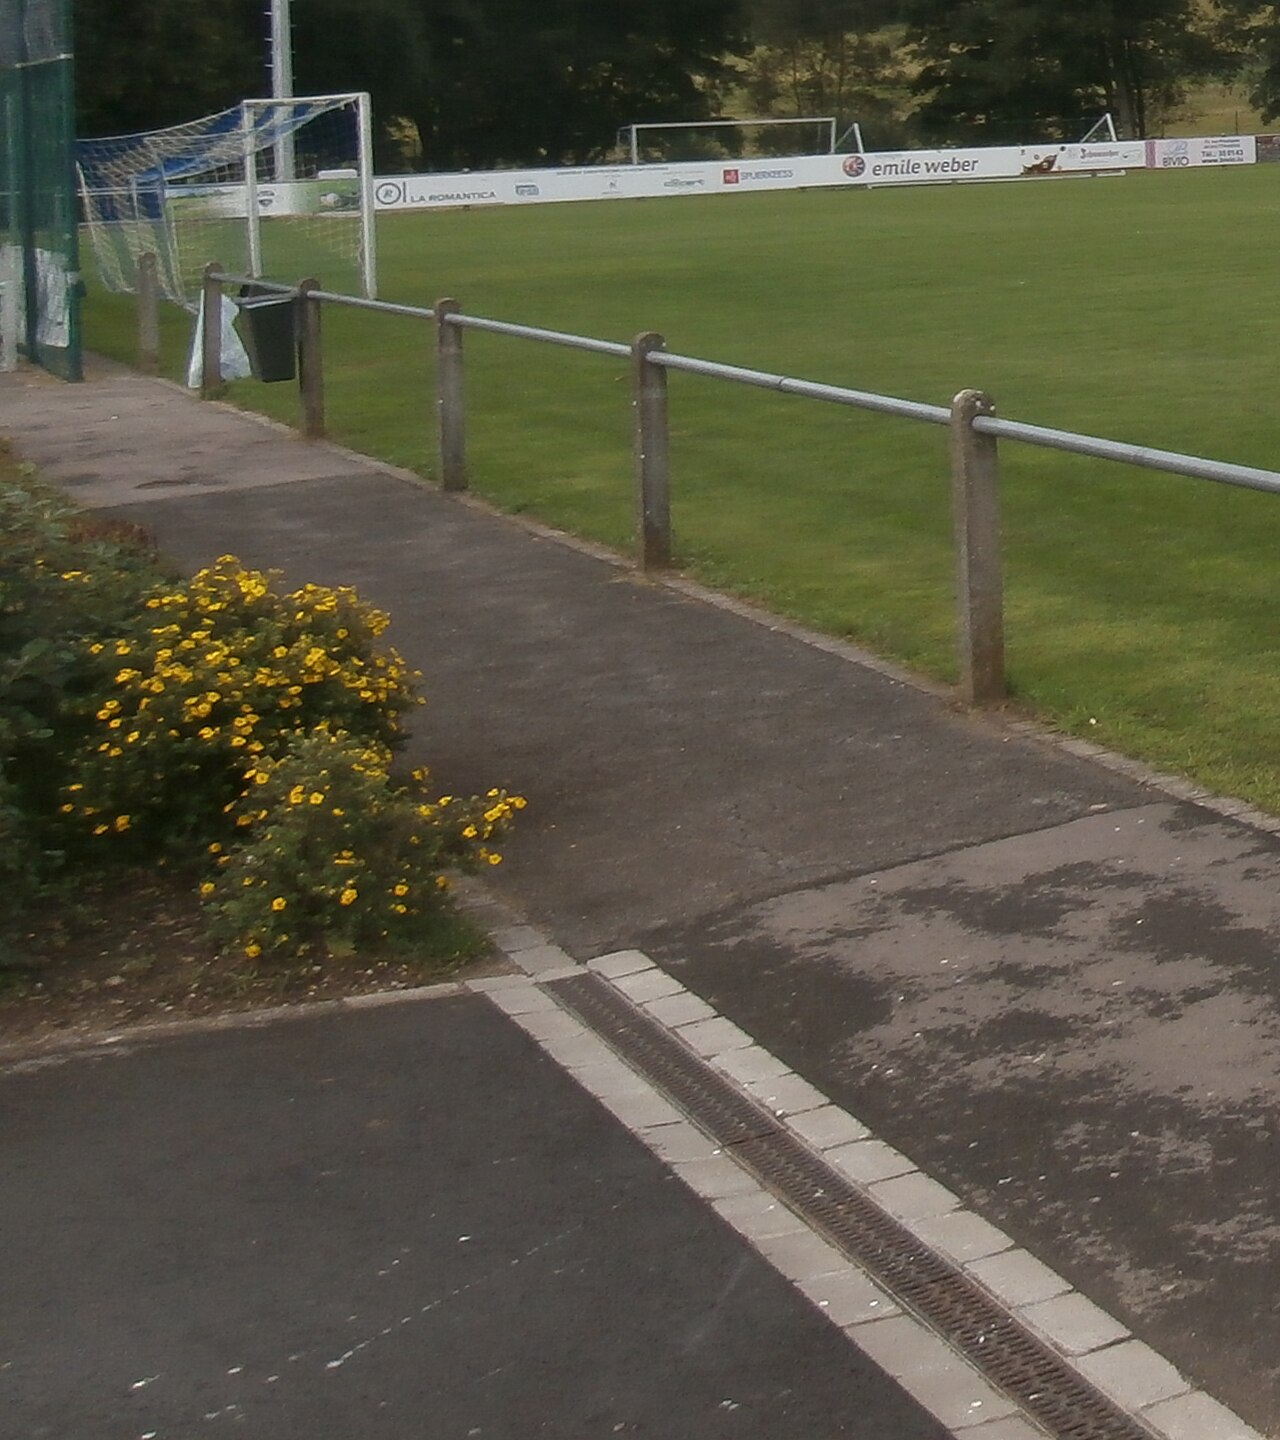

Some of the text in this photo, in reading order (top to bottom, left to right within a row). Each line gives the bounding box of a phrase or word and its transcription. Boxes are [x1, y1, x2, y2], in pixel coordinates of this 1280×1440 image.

[872, 157, 979, 177] emile weber
[410, 191, 496, 203] LA ROMANTICA
